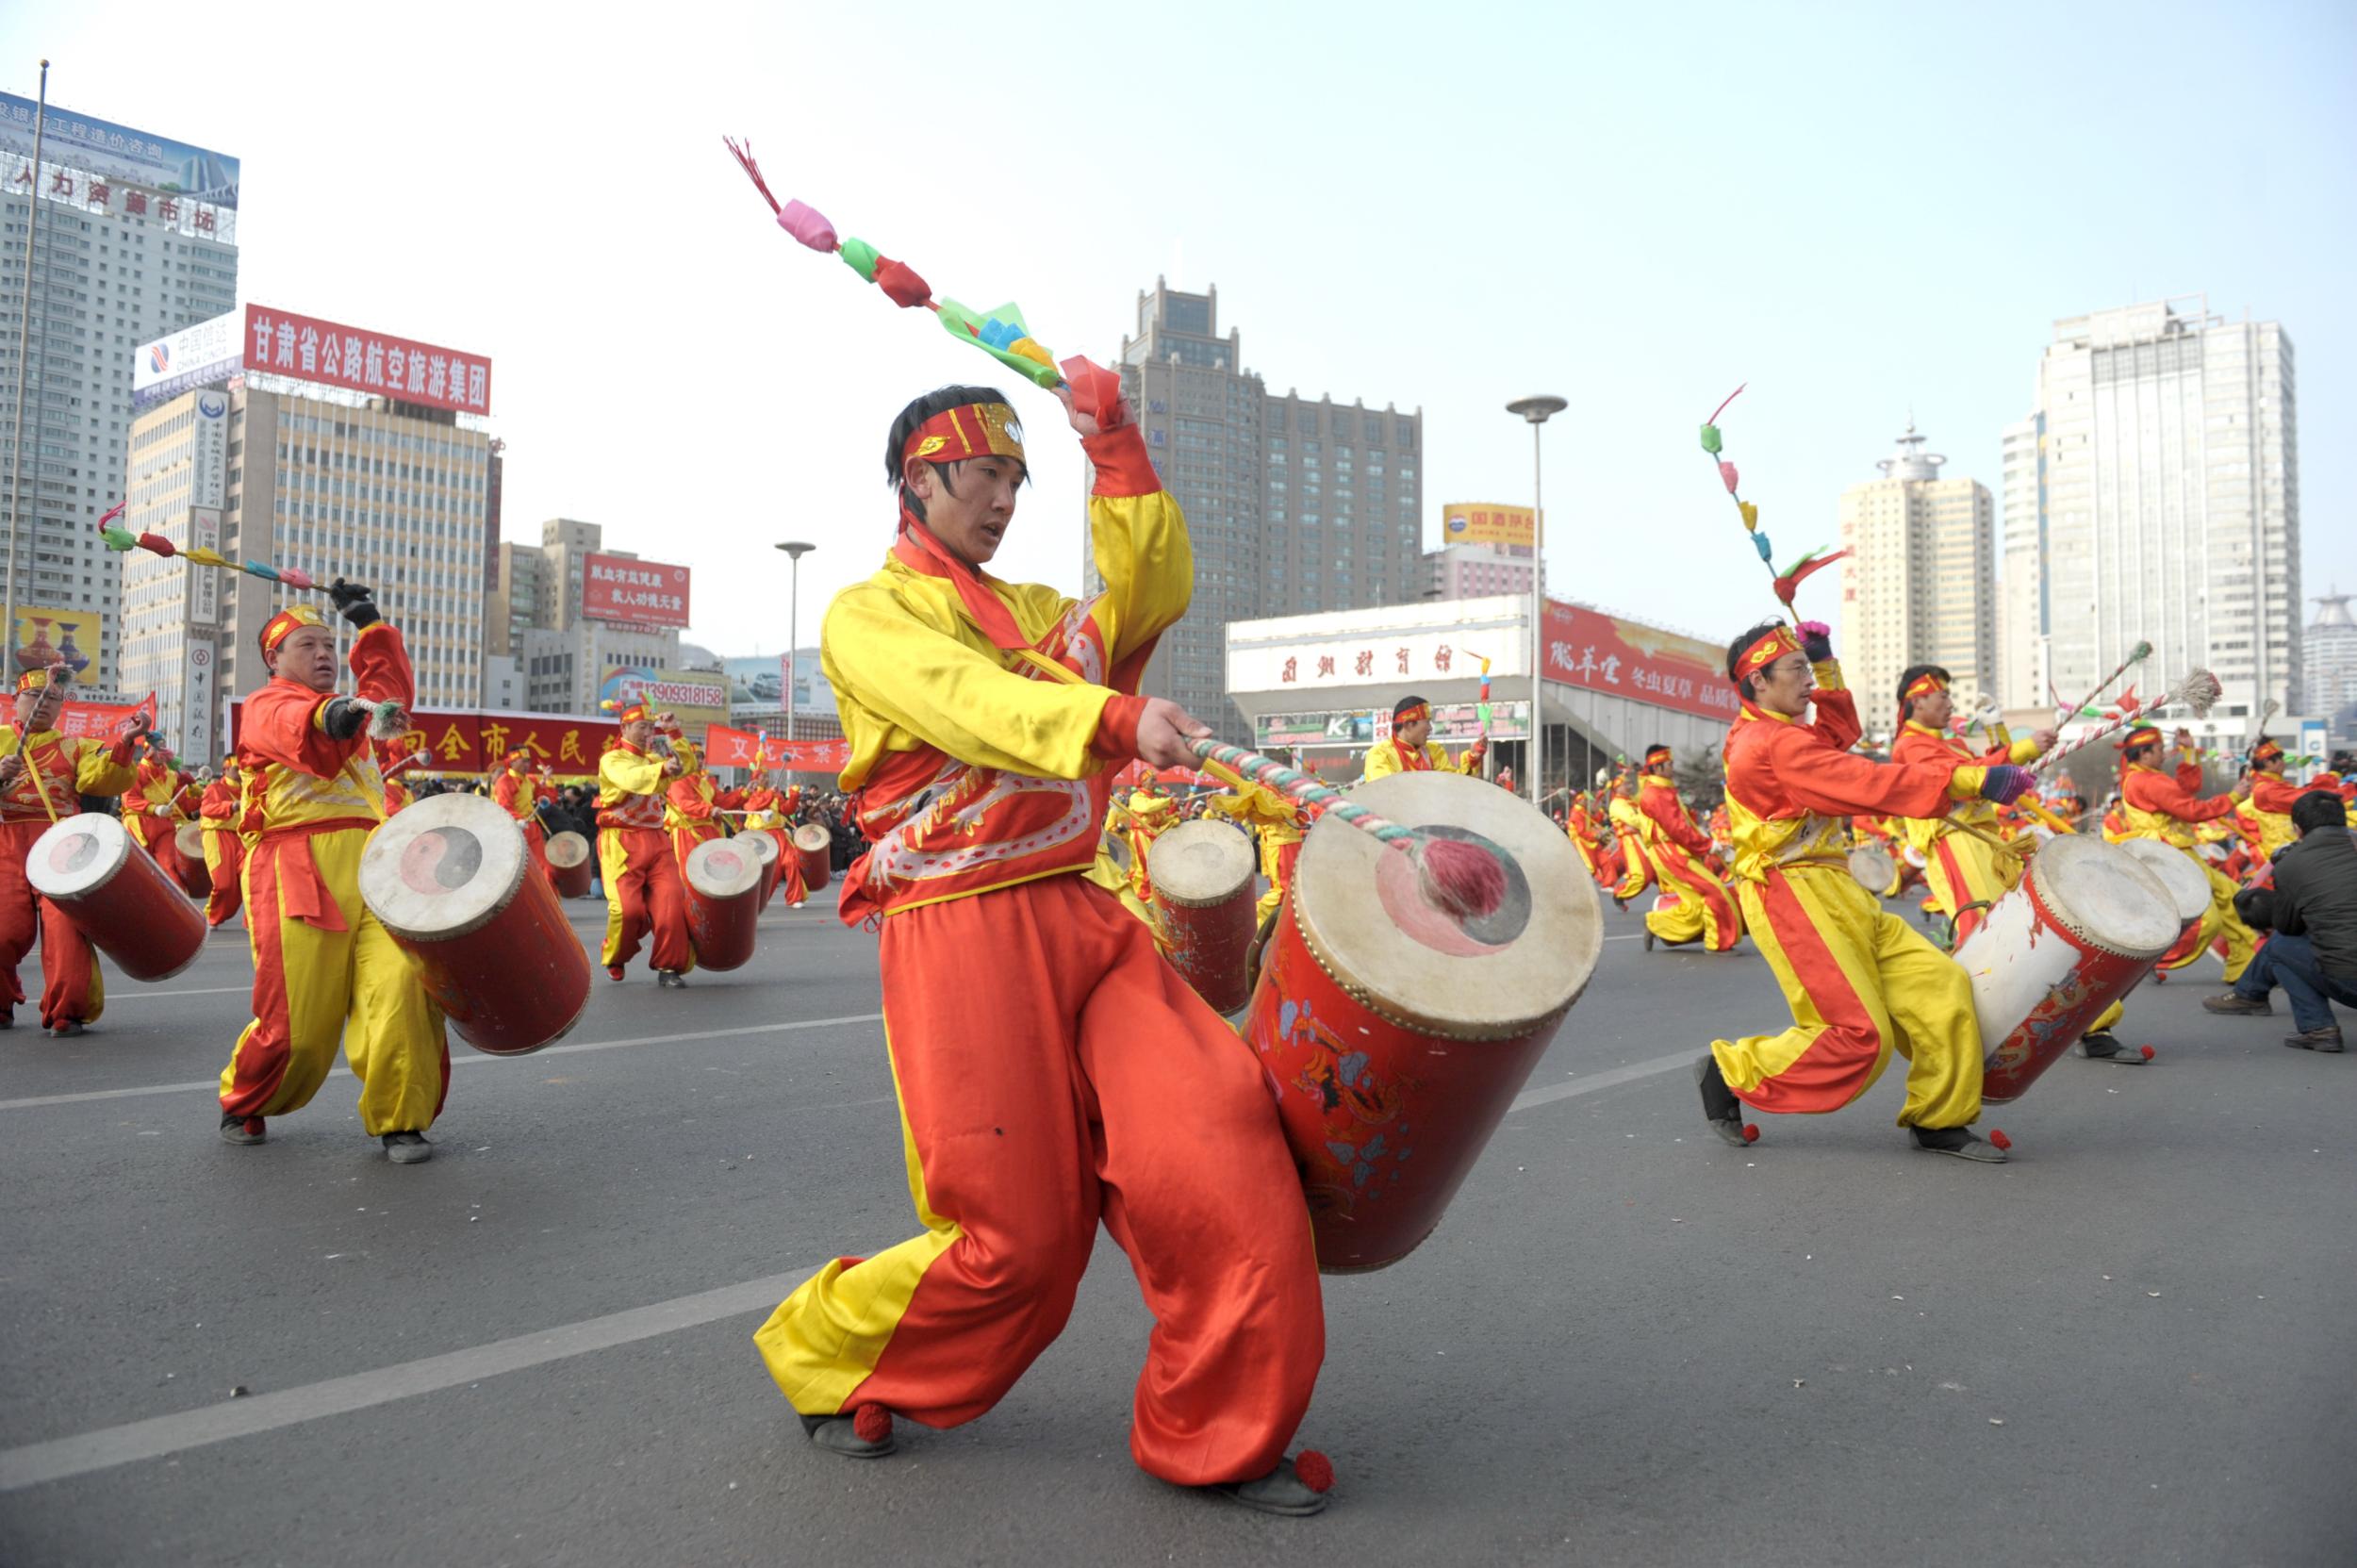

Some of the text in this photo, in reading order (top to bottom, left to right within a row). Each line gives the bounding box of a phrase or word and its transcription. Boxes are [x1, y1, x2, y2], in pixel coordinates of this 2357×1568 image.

[15, 165, 215, 232] 人力资源市场
[253, 315, 486, 409] 甘肃省公路航空旅游集团
[202, 531, 217, 615] 中国资产管理公司
[190, 670, 206, 739] 中国银行
[645, 682, 722, 705] 13909318158
[1631, 667, 1694, 699] 冬虫夏草
[401, 721, 615, 766] 向全市人民
